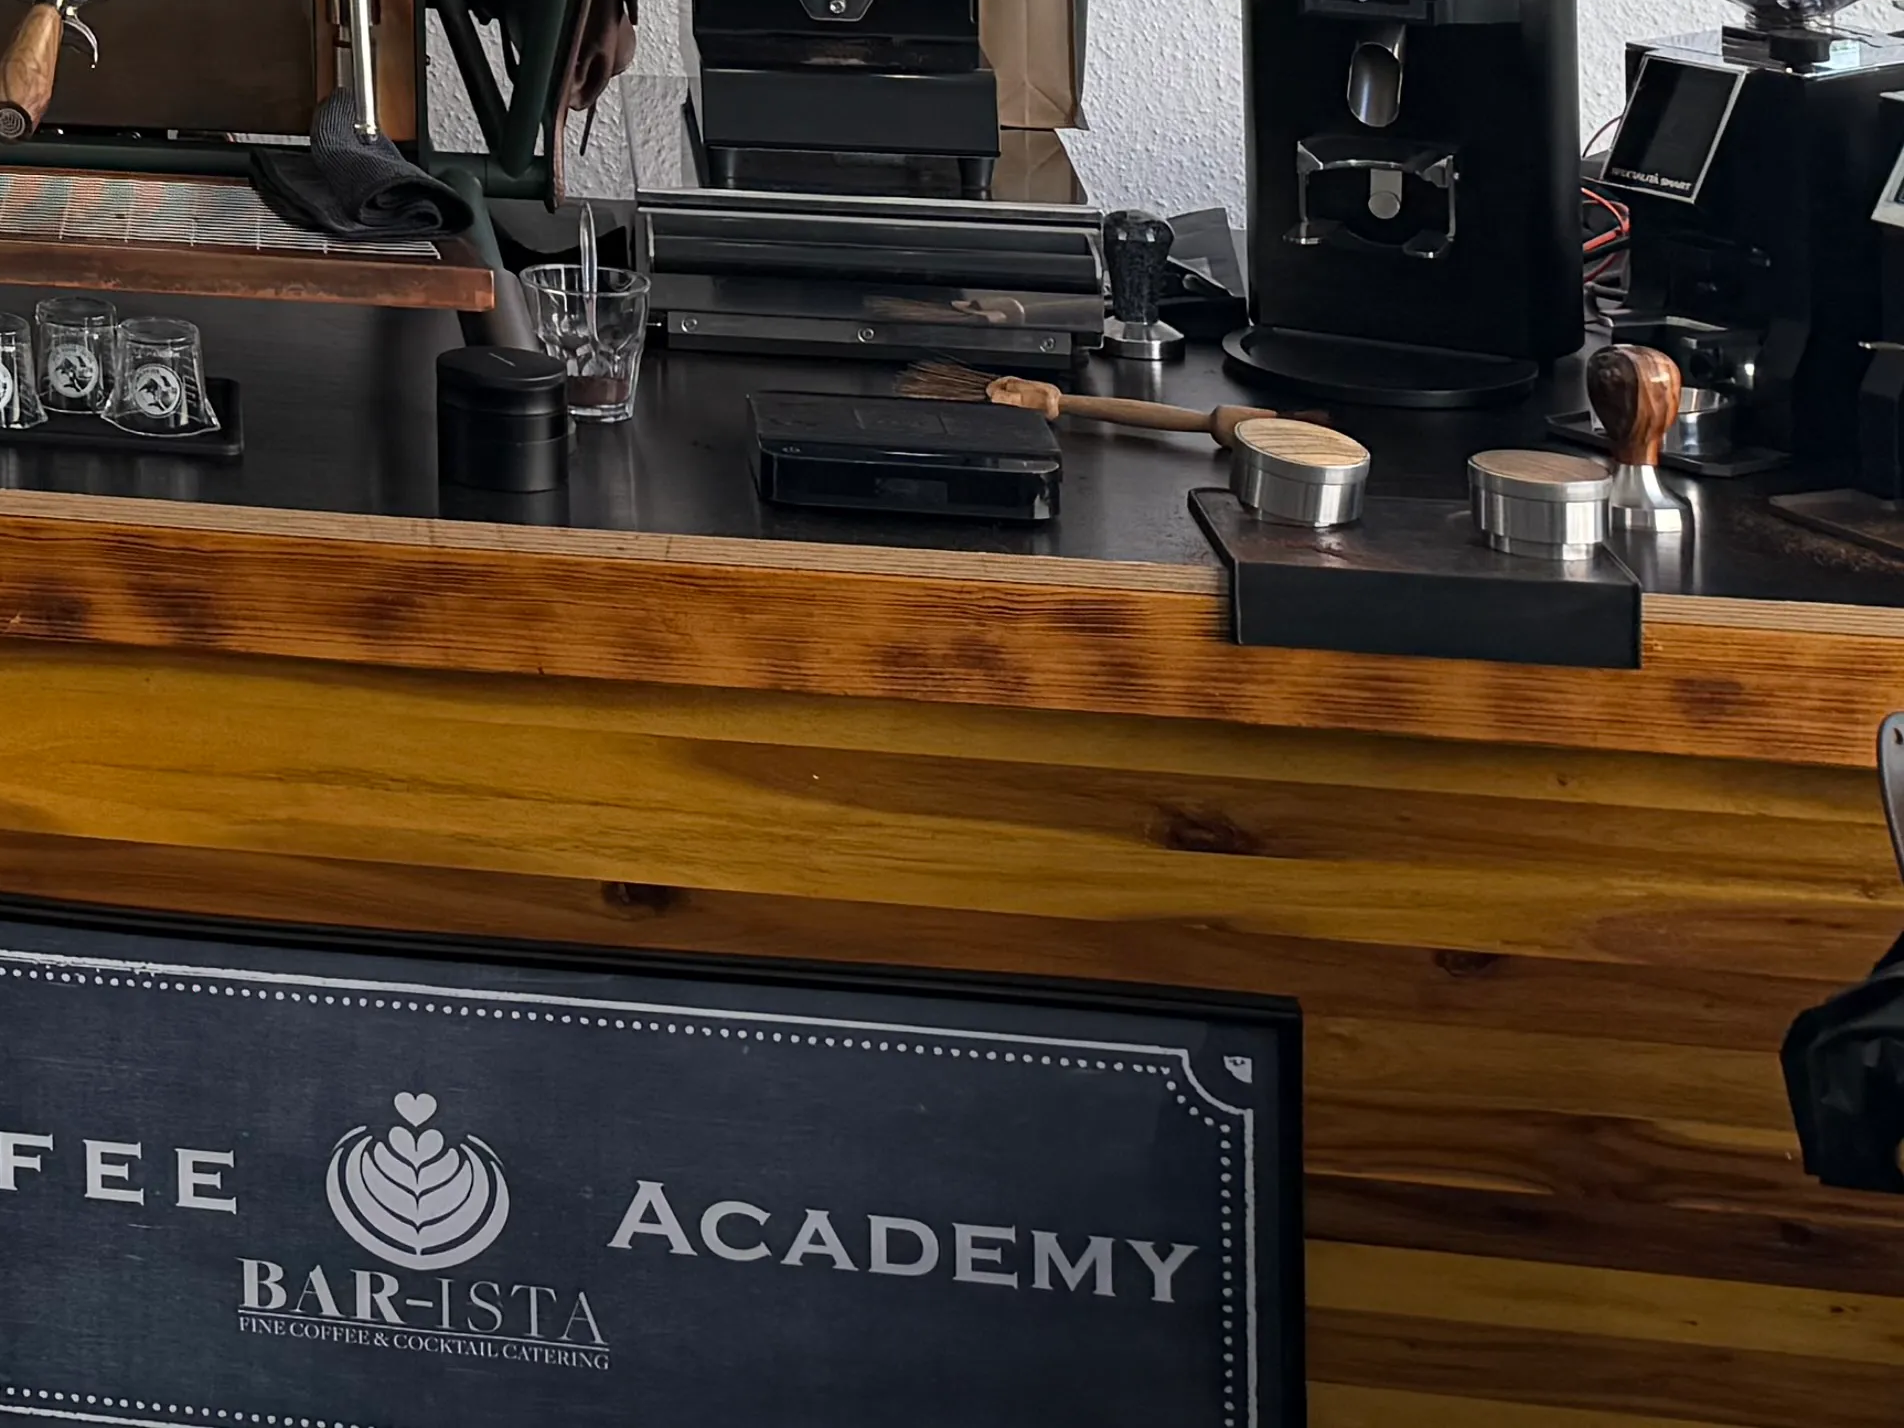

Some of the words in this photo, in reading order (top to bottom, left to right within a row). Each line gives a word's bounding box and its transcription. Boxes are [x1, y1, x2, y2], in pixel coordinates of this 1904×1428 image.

[608, 1180, 1201, 1306] ACADEMY
[238, 1257, 610, 1346] BAR-ISTA
[239, 1316, 288, 1336] FINE
[291, 1318, 373, 1347] COFFEE
[375, 1327, 390, 1347] &
[392, 1332, 493, 1362] COCKTAIL
[495, 1342, 610, 1372] CATERING
